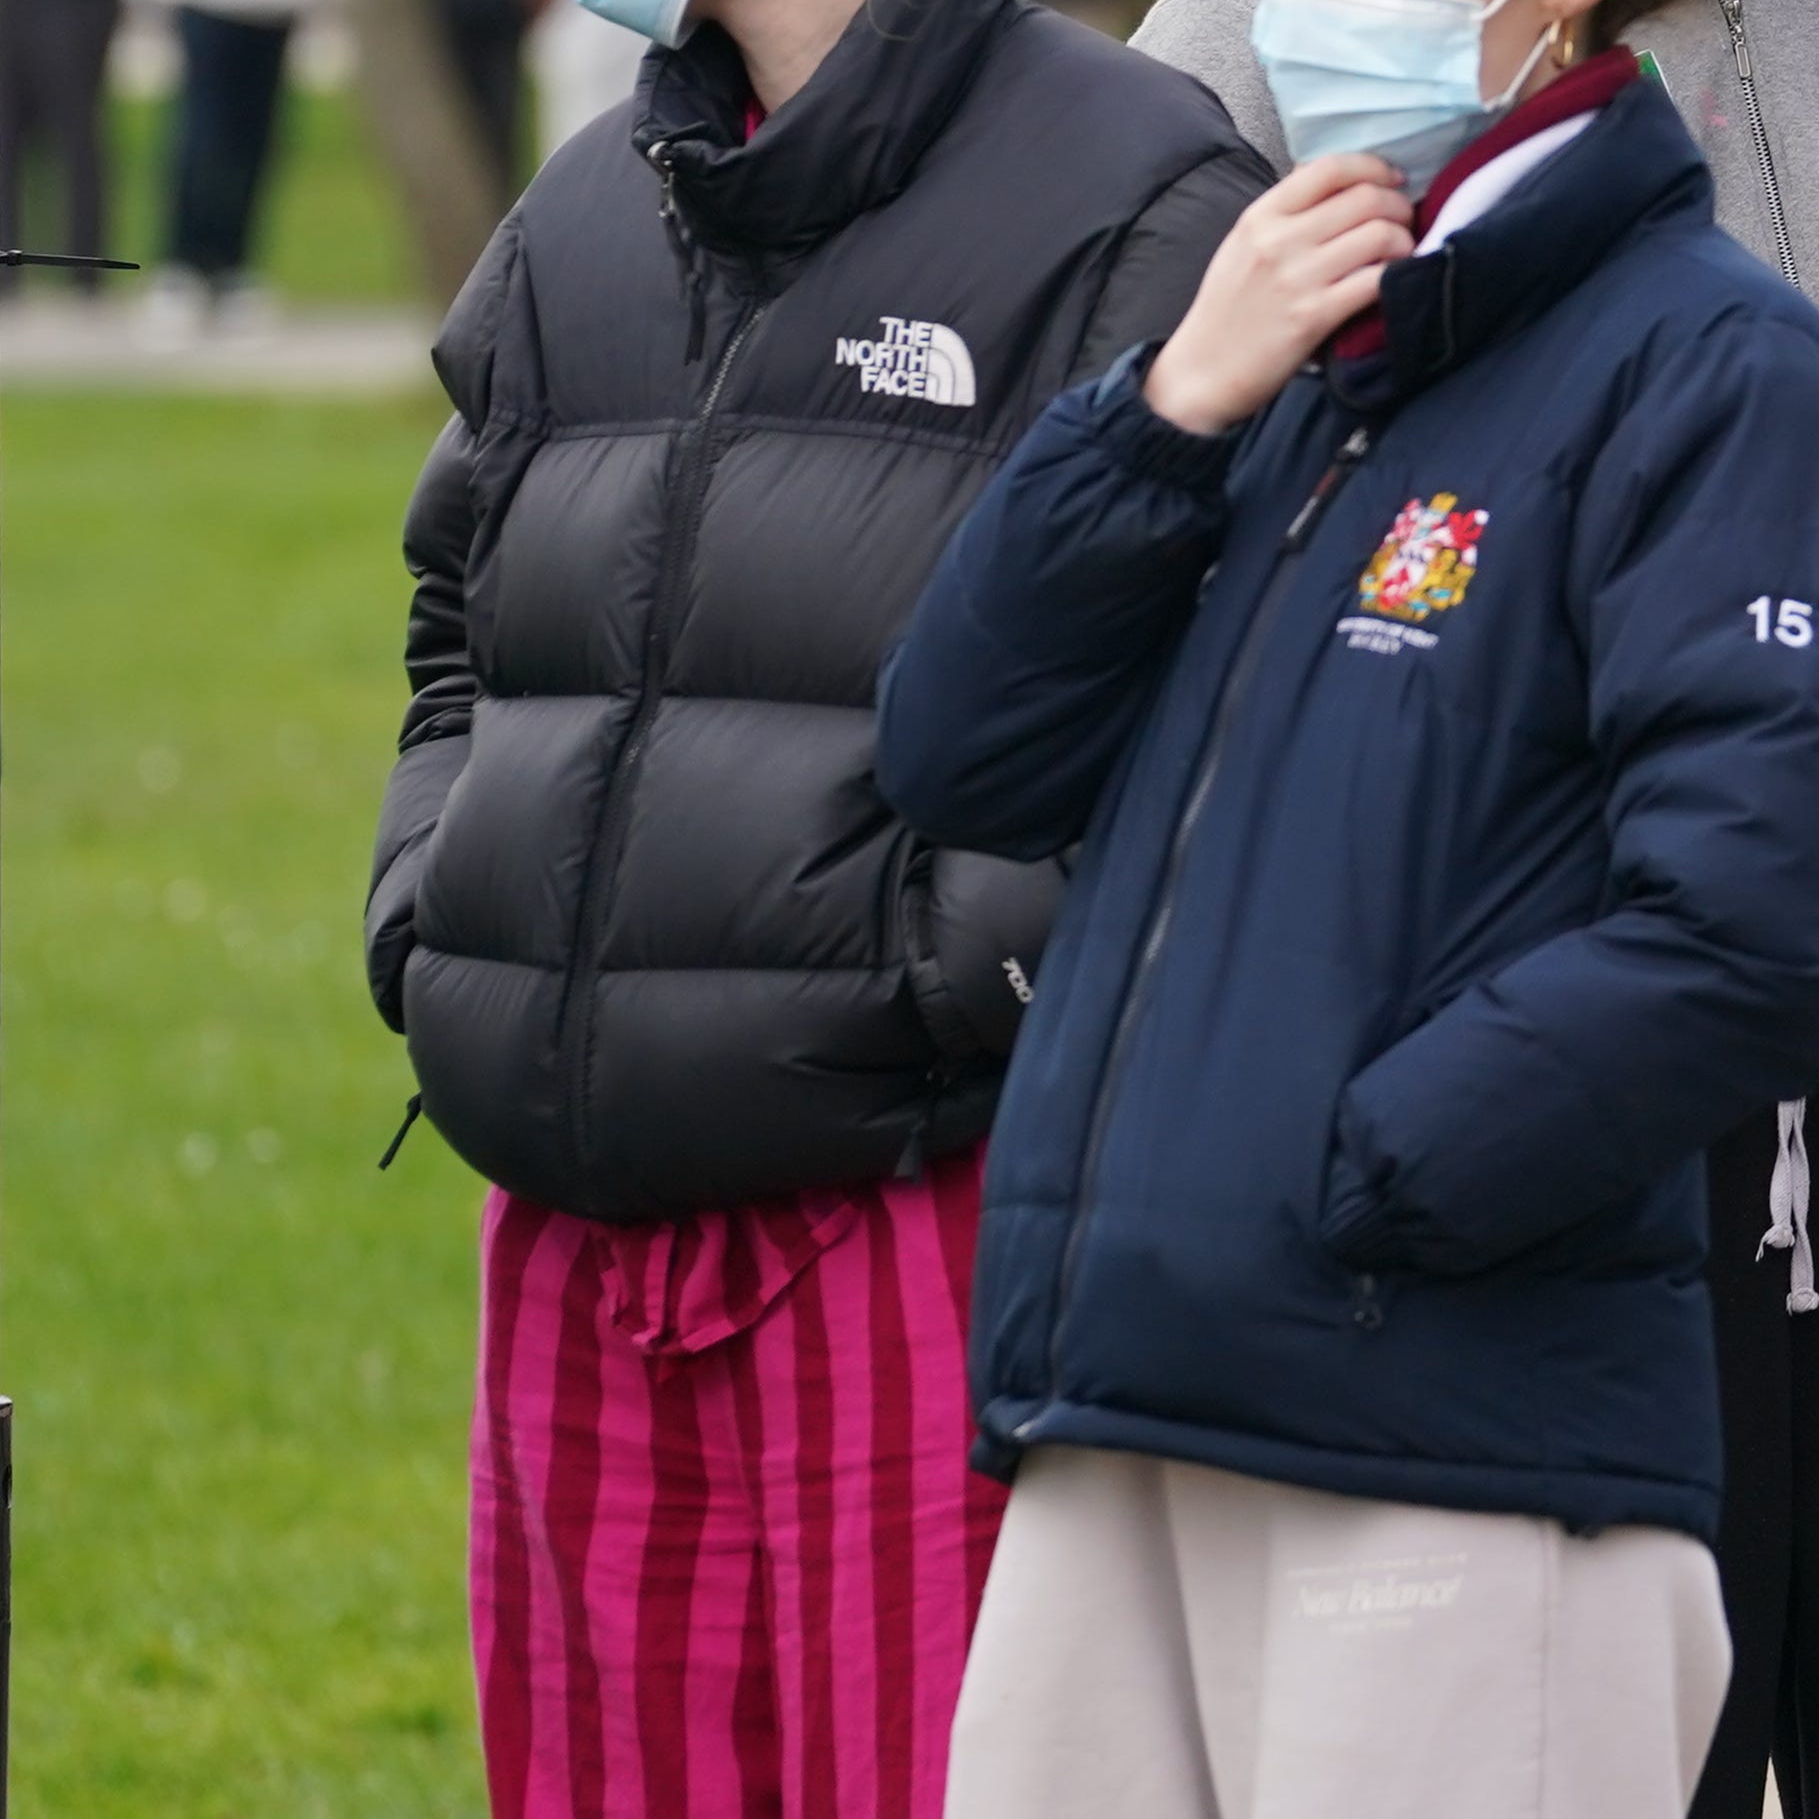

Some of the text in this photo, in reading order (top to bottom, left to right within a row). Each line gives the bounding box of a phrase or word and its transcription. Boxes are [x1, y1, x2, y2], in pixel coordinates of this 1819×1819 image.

[879, 316, 934, 348] THE
[835, 337, 929, 373] NORTH
[861, 365, 926, 398] FACE
[1746, 595, 1813, 648] 15
[1001, 957, 1035, 1003] 700
